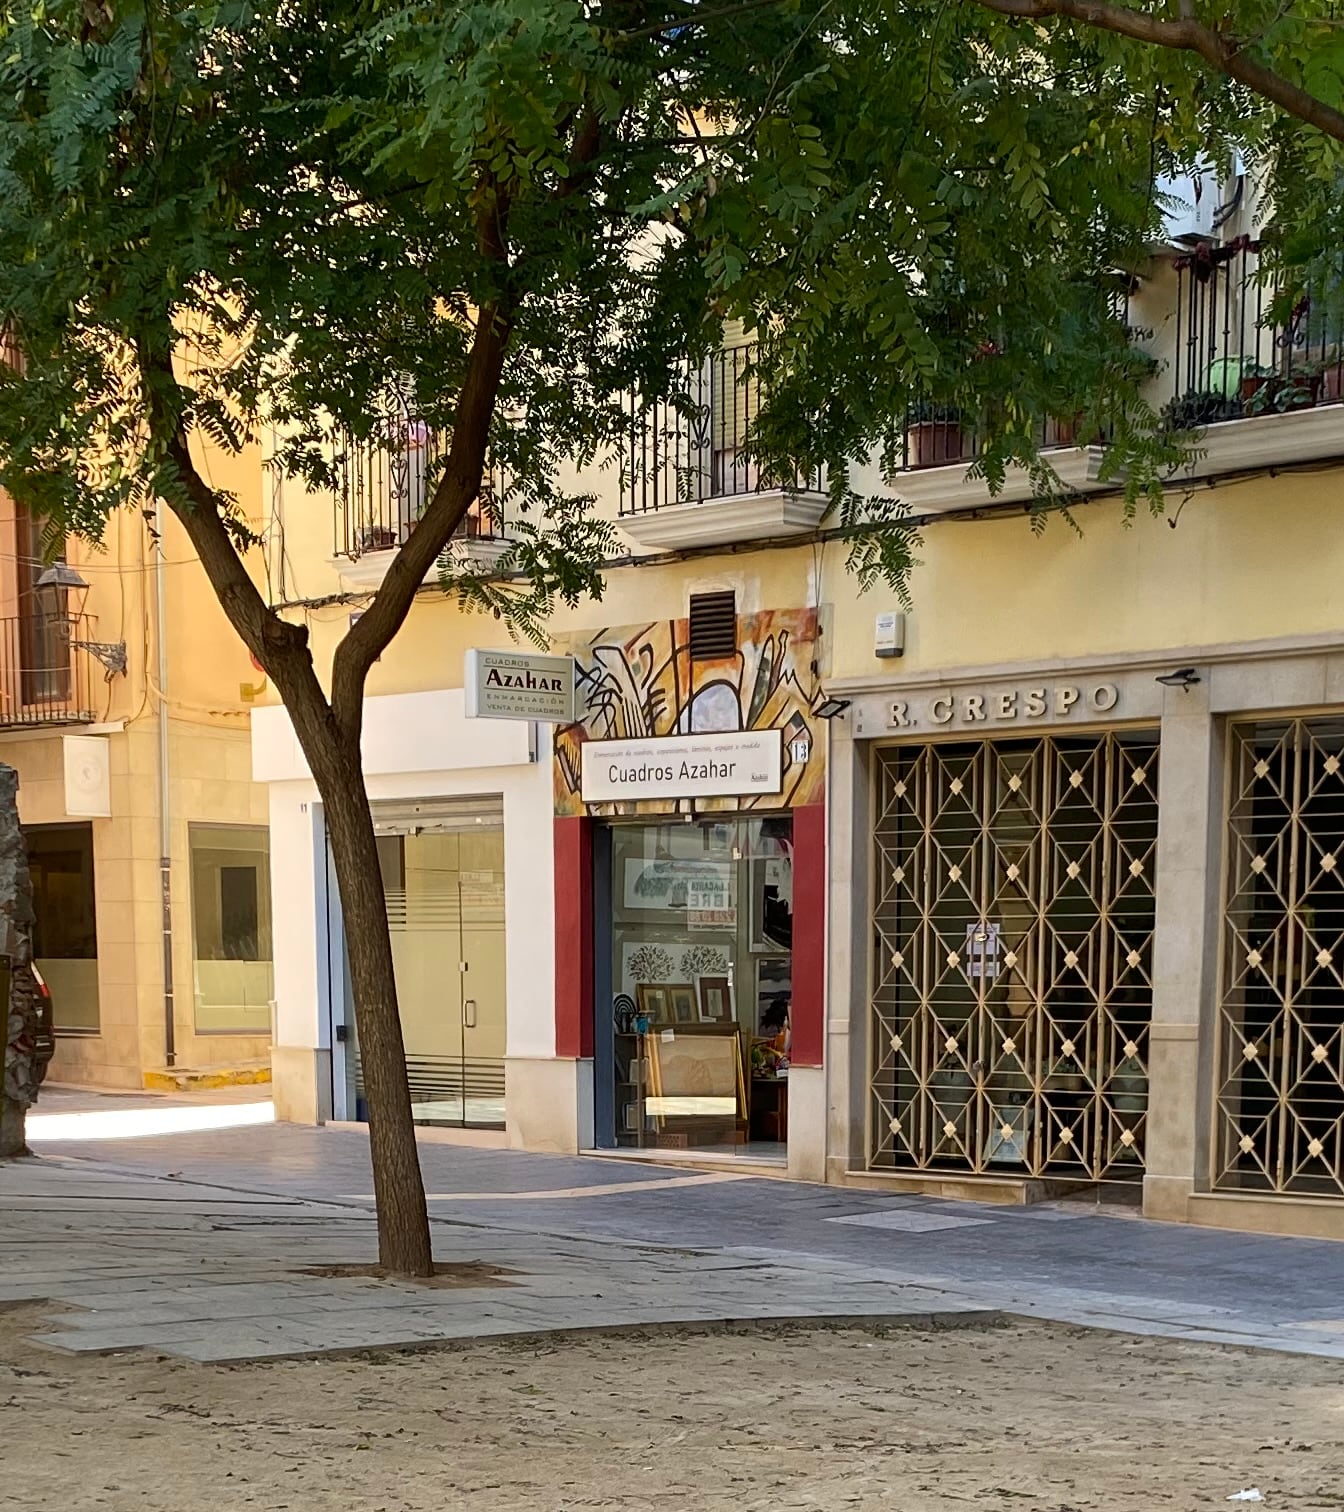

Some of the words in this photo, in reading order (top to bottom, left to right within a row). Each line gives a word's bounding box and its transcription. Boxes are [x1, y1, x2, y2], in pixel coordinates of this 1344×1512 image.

[485, 657, 530, 668] CUADROS
[927, 683, 1119, 725] CRESPO
[608, 762, 673, 783] Cuadros
[679, 760, 737, 780] Azahar
